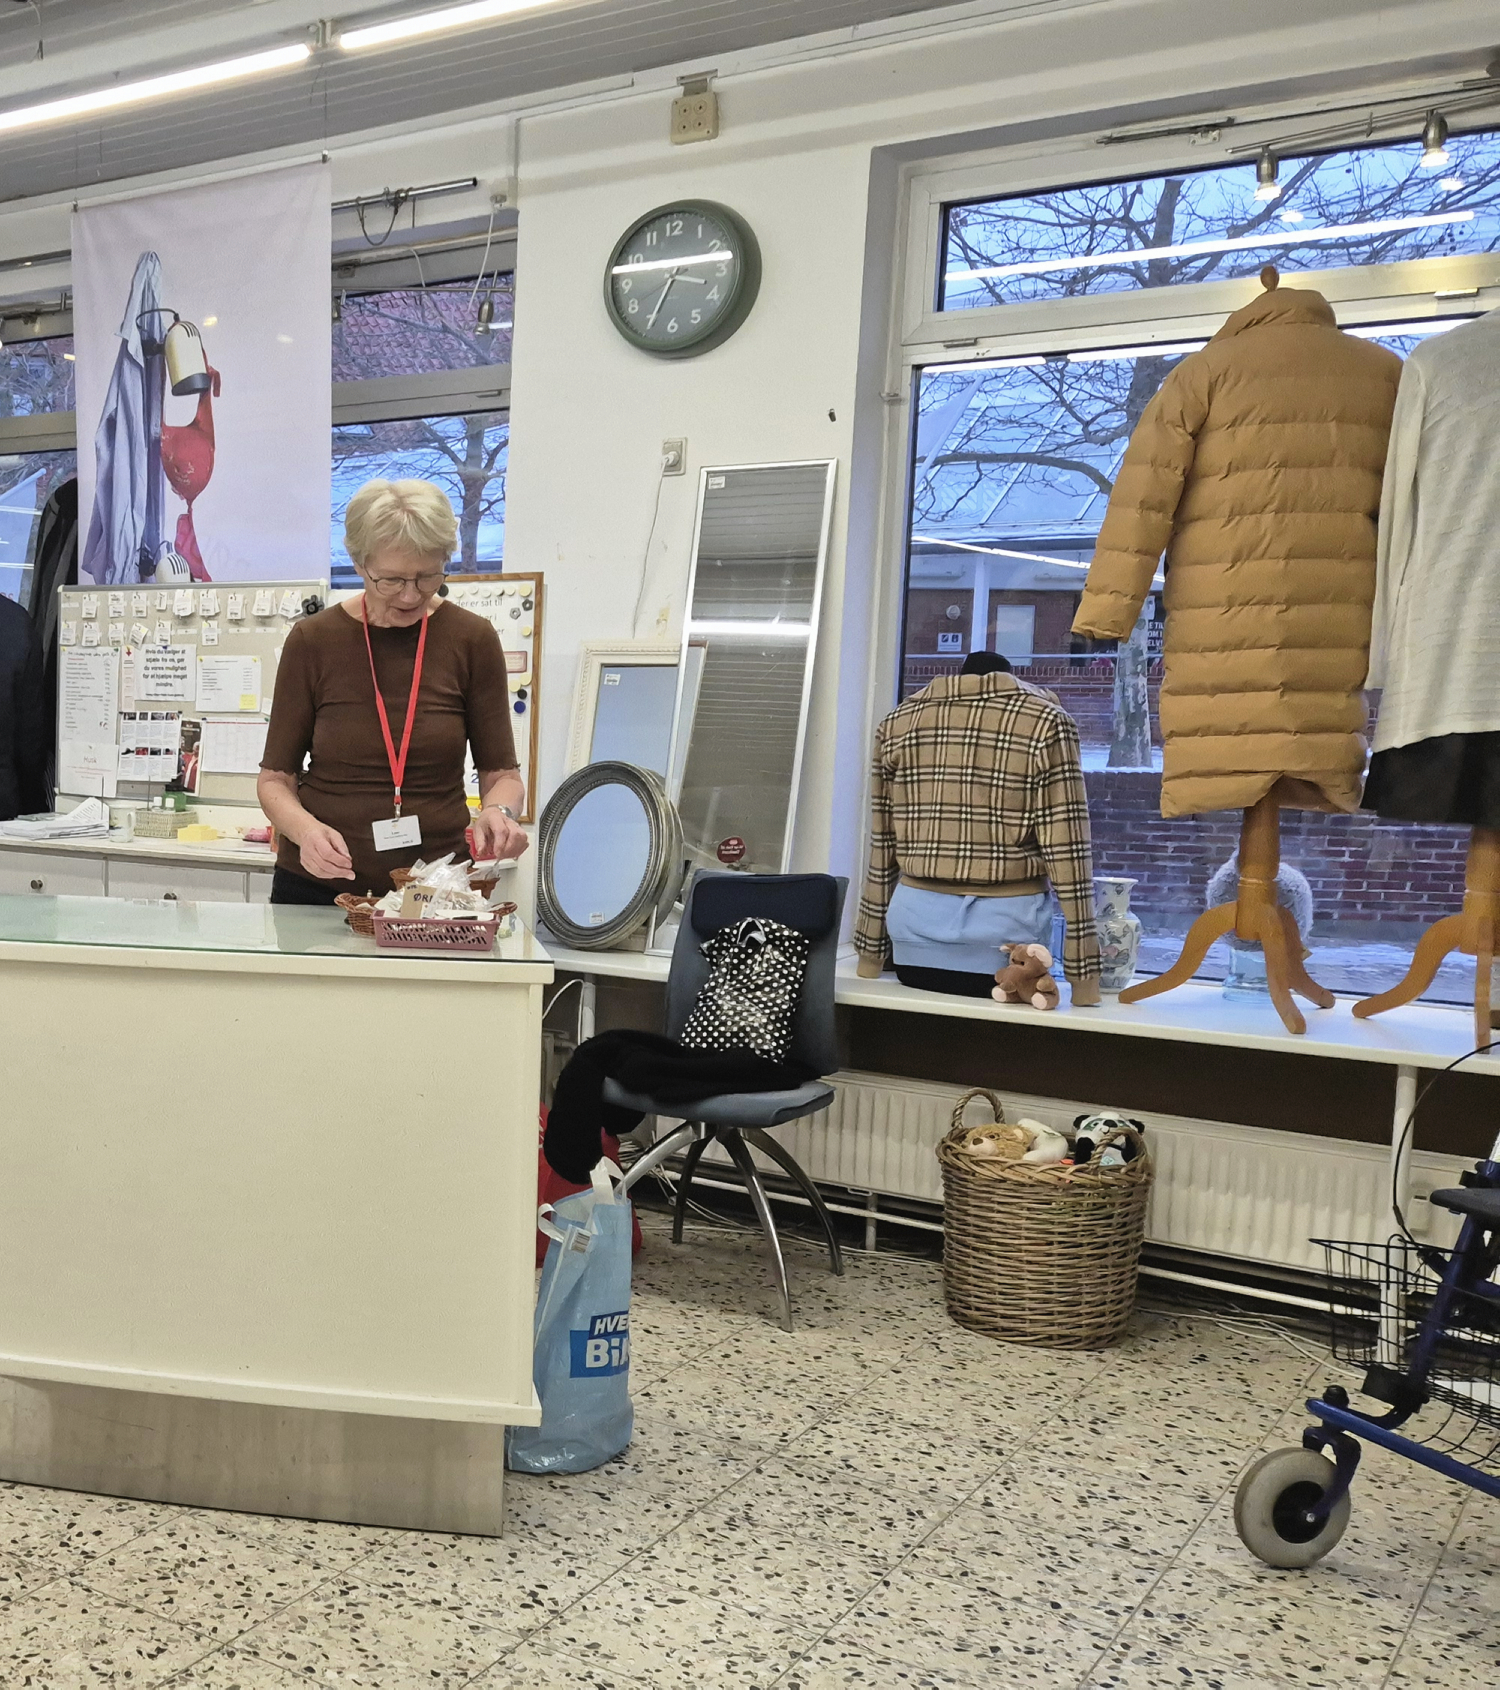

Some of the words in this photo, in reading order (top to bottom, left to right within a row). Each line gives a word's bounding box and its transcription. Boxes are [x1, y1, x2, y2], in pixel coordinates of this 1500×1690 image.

[666, 220, 683, 237] 12
[646, 231, 657, 246] 11
[709, 239, 721, 253] 2
[715, 262, 728, 277] 3
[622, 279, 632, 294] 9
[705, 285, 720, 300] 4
[628, 298, 639, 314] 8
[690, 308, 701, 324] 5
[667, 317, 678, 333] 6
[495, 597, 503, 606] til
[594, 1314, 629, 1336] HVE
